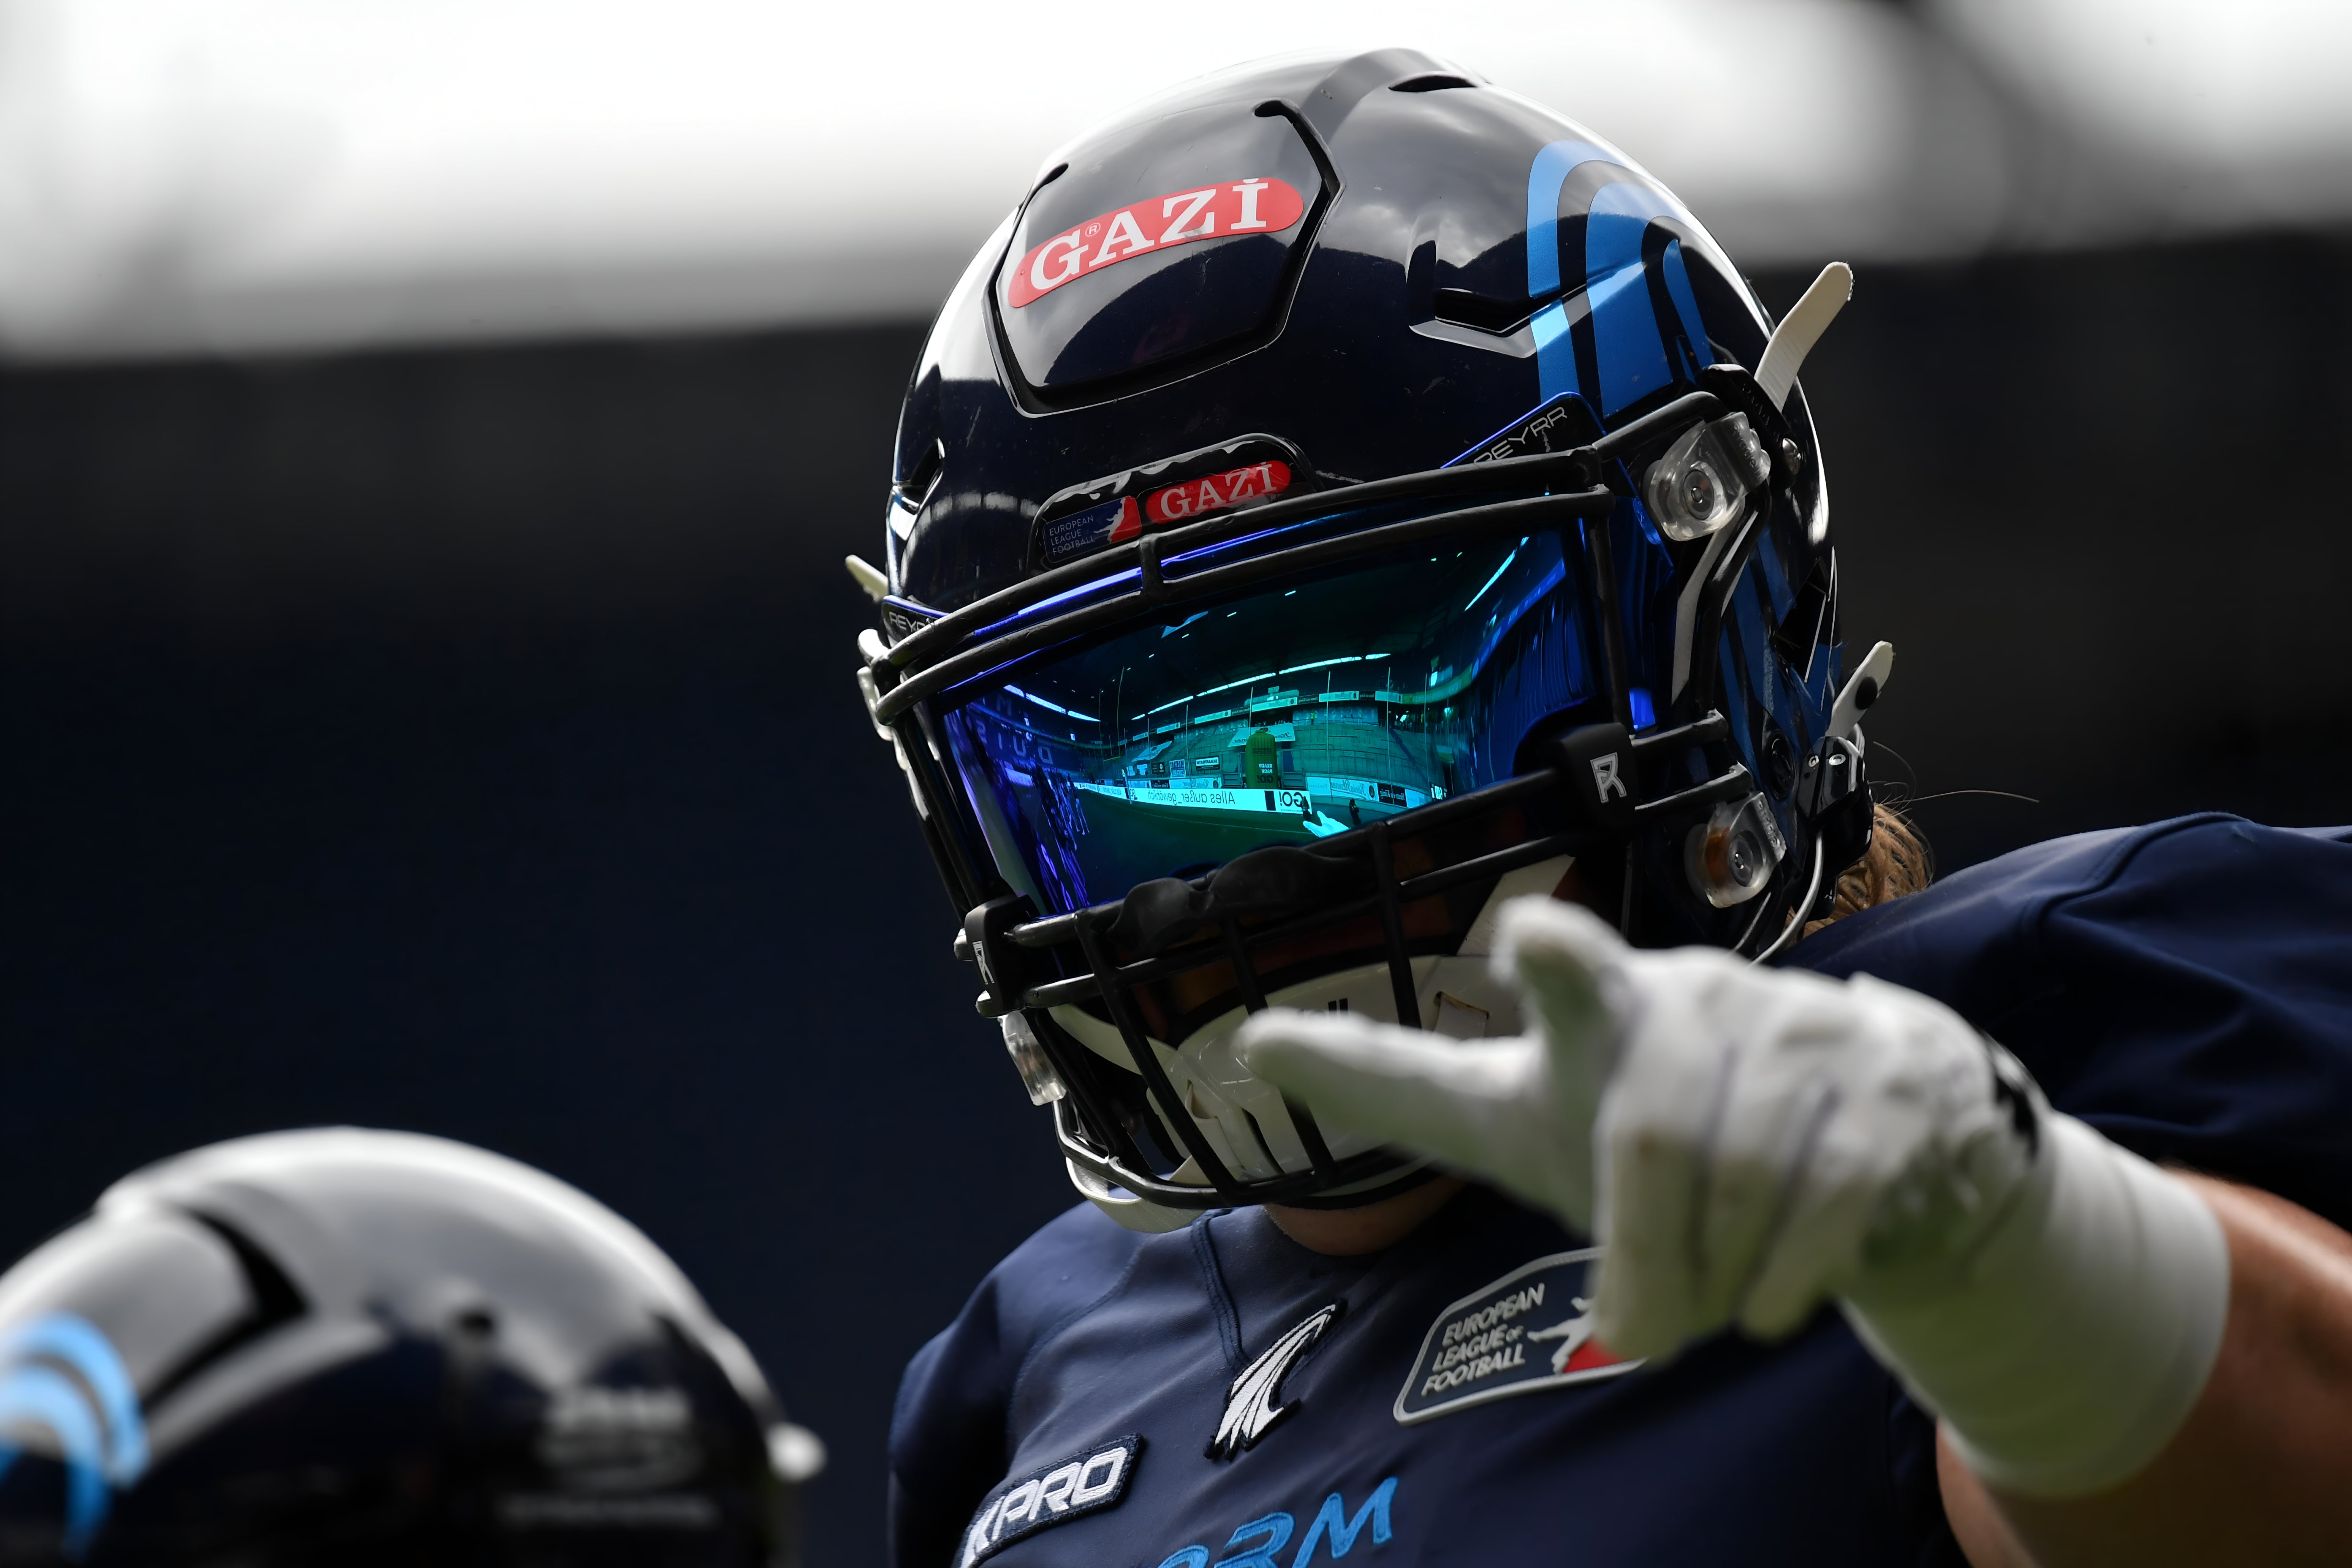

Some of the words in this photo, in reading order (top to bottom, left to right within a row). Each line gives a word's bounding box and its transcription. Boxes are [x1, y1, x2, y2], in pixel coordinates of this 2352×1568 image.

[1049, 515, 1094, 536] EUROPEAN
[1051, 529, 1082, 546] LEAGUE
[1053, 535, 1095, 555] FOOTBALL
[889, 611, 929, 633] REYR
[1442, 1282, 1545, 1347] EUROPEAN
[1432, 1324, 1508, 1373] LEAGUE
[1421, 1344, 1526, 1396] FOOTBALL
